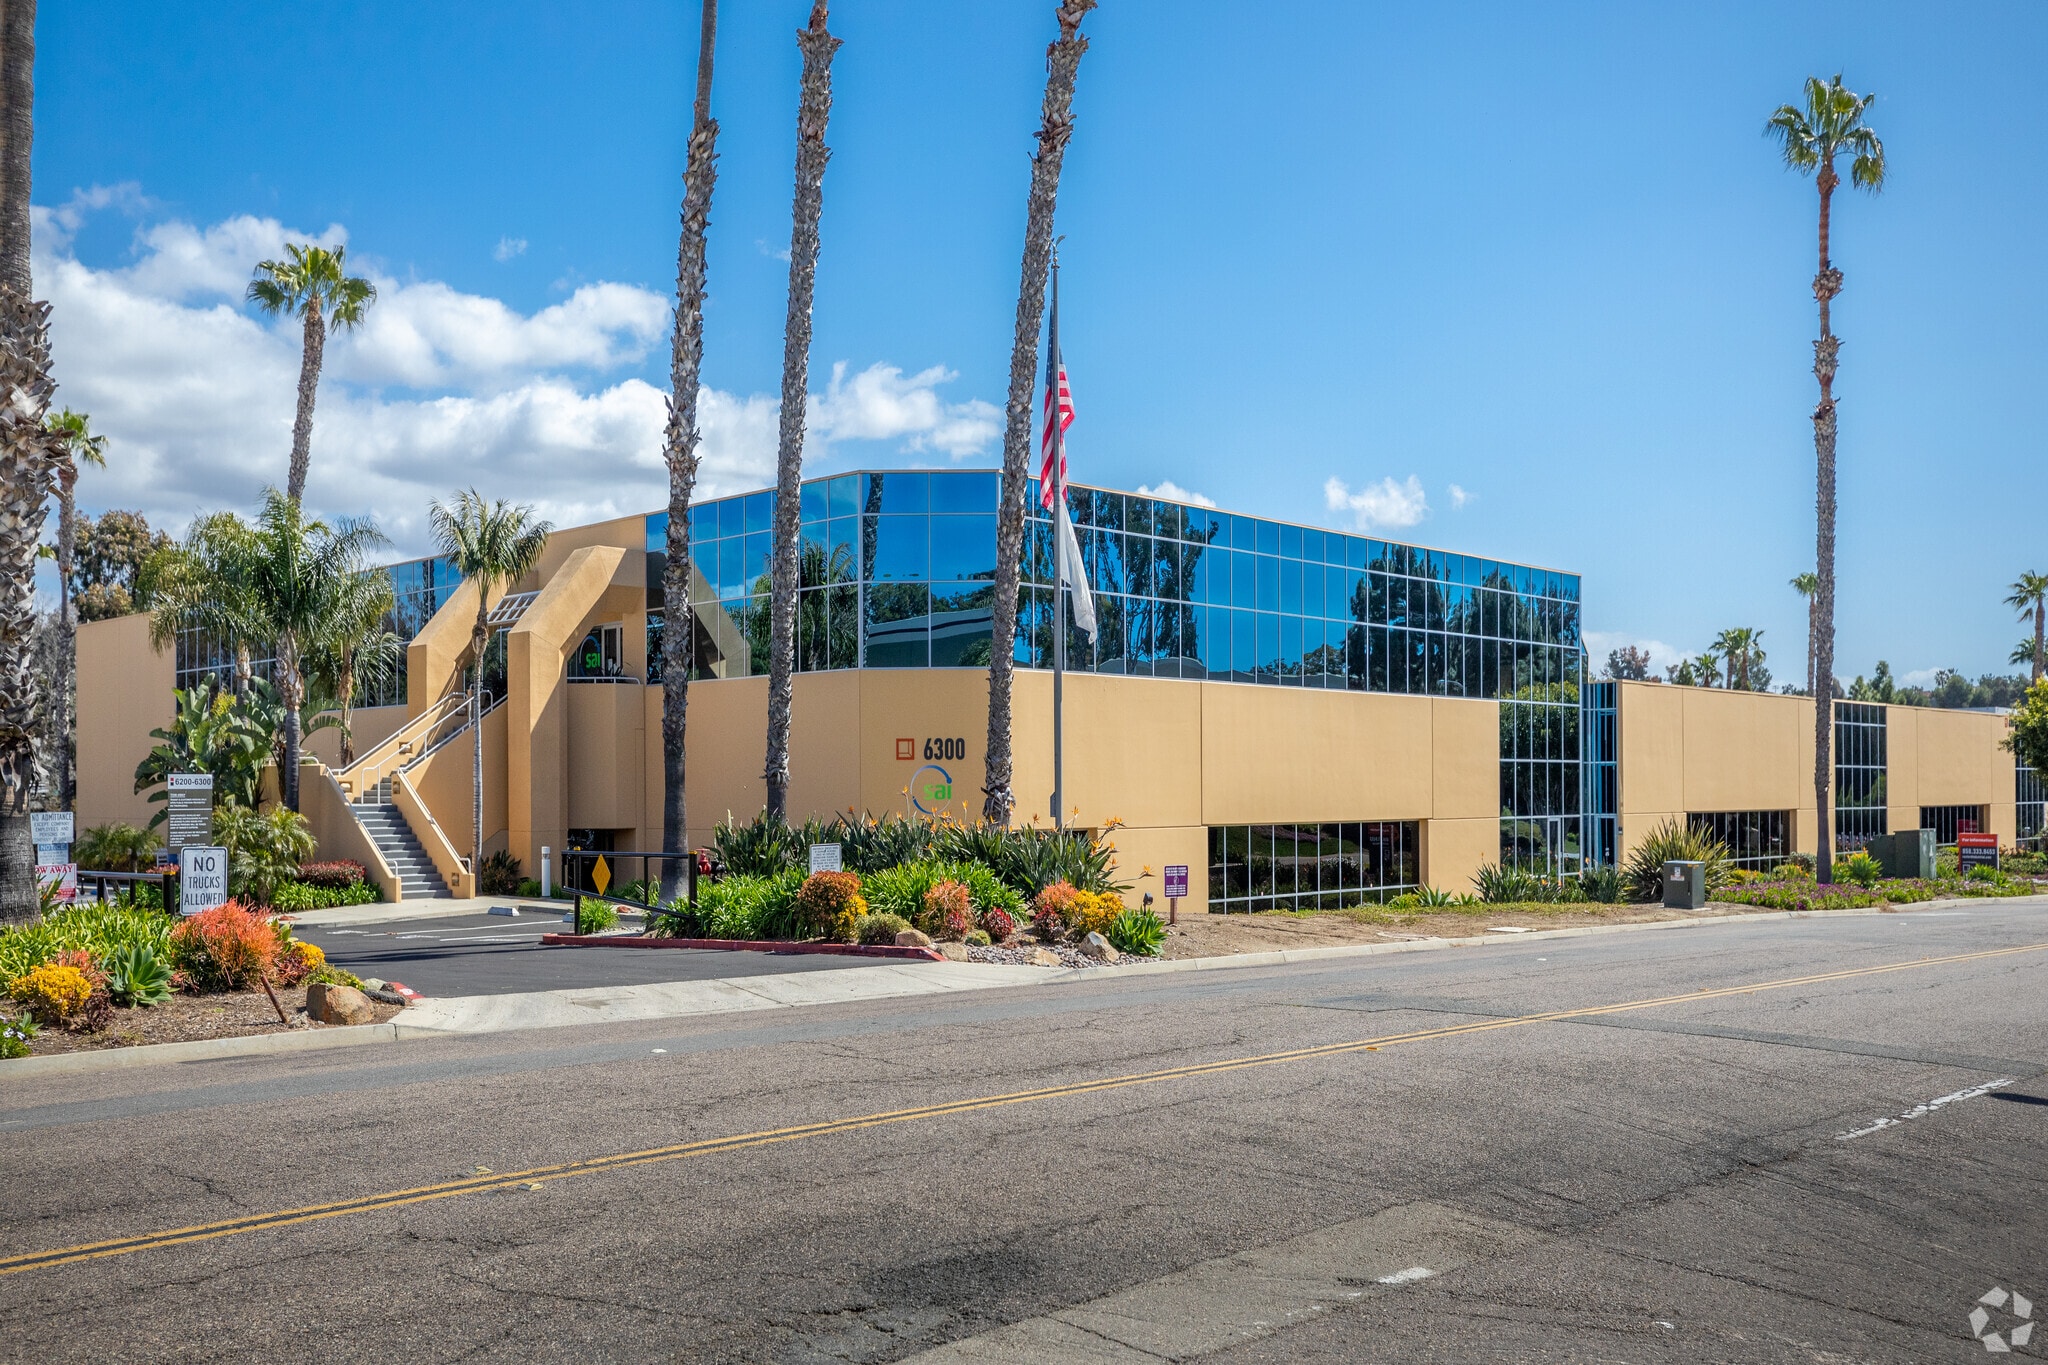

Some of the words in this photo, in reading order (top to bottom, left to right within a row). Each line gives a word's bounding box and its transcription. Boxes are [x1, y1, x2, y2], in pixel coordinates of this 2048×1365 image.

[924, 738, 965, 760] 6300
[175, 778, 211, 786] 6200-6300
[923, 784, 952, 800] sai
[42, 813, 72, 821] ADMITTANCE
[50, 865, 73, 873] AWAY
[194, 857, 215, 872] NO
[188, 876, 221, 889] TRUCKS
[184, 892, 223, 906] ALLOWED
